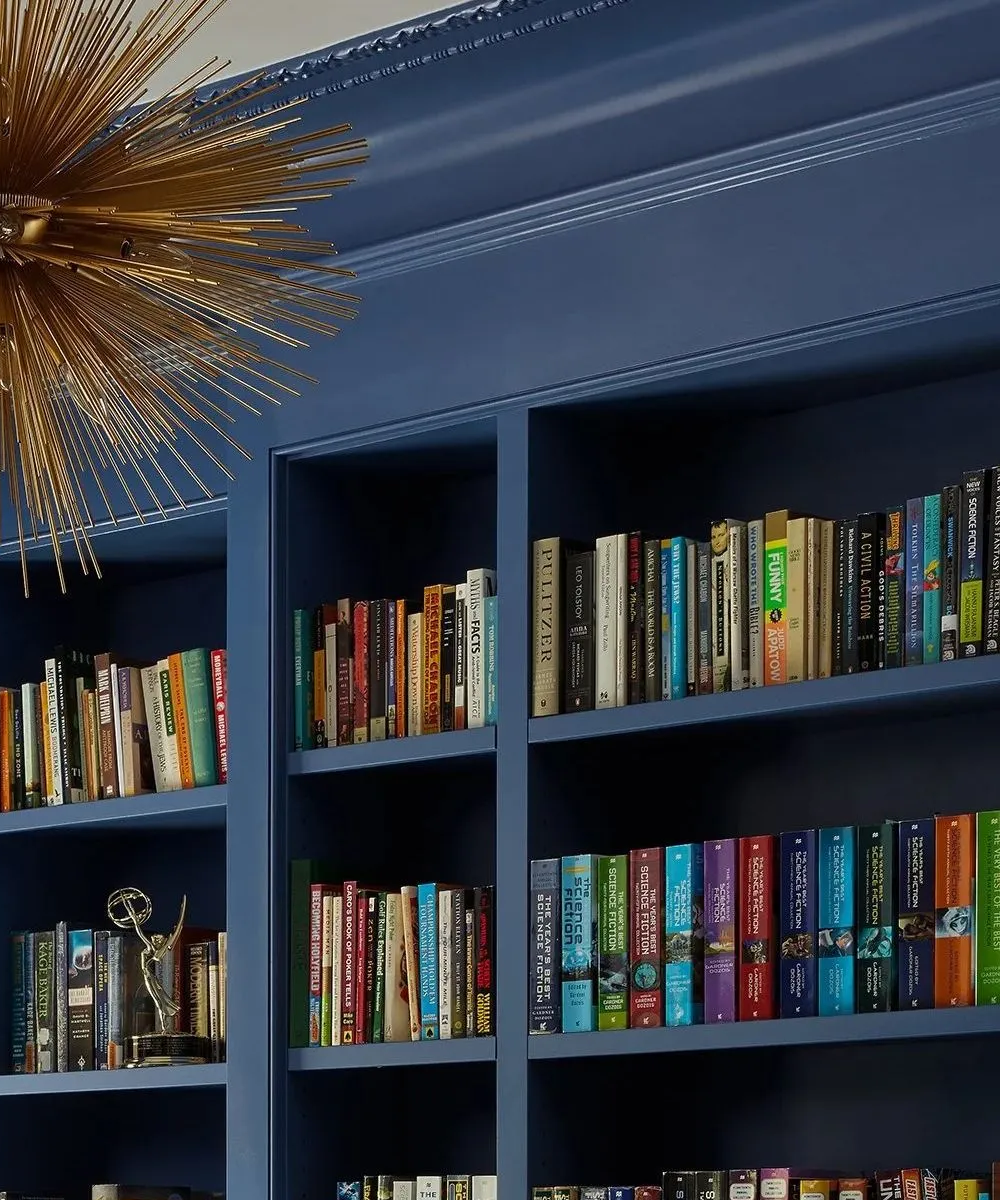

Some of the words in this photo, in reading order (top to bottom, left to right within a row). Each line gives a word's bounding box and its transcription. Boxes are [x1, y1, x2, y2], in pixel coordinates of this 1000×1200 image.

[968, 498, 977, 529] SCIENCE
[860, 532, 872, 540] A
[911, 524, 919, 560] TOLKIEN
[968, 530, 977, 559] FICTION
[672, 544, 680, 561] WHY
[860, 543, 872, 575] CIVIL
[575, 565, 583, 581] LEO
[672, 565, 680, 579] THE
[768, 553, 781, 603] FUNNY
[911, 564, 919, 580] THE
[469, 579, 481, 610] MYTHS
[541, 549, 553, 663] PULITZER
[575, 583, 583, 619] TOLSTOY
[672, 579, 680, 604] JEWS?
[860, 579, 872, 620] ACTION
[429, 593, 440, 655] MICHAEL
[749, 607, 760, 635] BIBLE?
[910, 585, 919, 648] SILMARILLION
[409, 624, 419, 674] Watership
[471, 620, 481, 654] FACTS
[648, 637, 655, 645] IS
[777, 627, 785, 650] JUDD
[766, 628, 781, 681] APATOW
[47, 667, 57, 705] MICHAEL
[97, 669, 110, 693] MARK
[213, 655, 223, 699] MONEYBALL
[411, 676, 419, 706] Down
[429, 662, 440, 725] CHABON
[49, 708, 58, 734] LEWIS
[99, 694, 111, 725] HELPRIN
[153, 701, 165, 732] HISTORY
[165, 701, 174, 733] REVIEW
[217, 714, 226, 747] MICHAEL
[51, 736, 59, 778] BOOMERANG
[157, 753, 167, 772] JEWS
[220, 749, 228, 772] LEWIS
[345, 885, 353, 915] CARO'S
[609, 868, 617, 908] SCIENCE
[641, 866, 650, 910] SCIENCE
[311, 891, 321, 941] BECOMING
[378, 901, 386, 917] Golf
[536, 894, 544, 949] SCIENCE
[544, 896, 552, 918] THE
[345, 916, 353, 939] BOOK
[609, 911, 617, 951] FICTION
[641, 913, 650, 955] FICTION
[38, 942, 48, 975] KAGE
[345, 941, 353, 952] OF
[376, 940, 384, 976] Explained
[544, 923, 552, 964] YEAR'S
[190, 957, 202, 1005] MODERN
[311, 942, 321, 991] HOLYFIELD
[345, 954, 353, 980] POKER
[536, 955, 544, 1003] FICTION
[38, 979, 48, 1018] BAKER
[345, 982, 353, 1007] TELLS
[544, 969, 552, 999] BEST
[893, 1175, 902, 1200] THE
[906, 1179, 917, 1199] FAST
[924, 1177, 934, 1196] FAST
